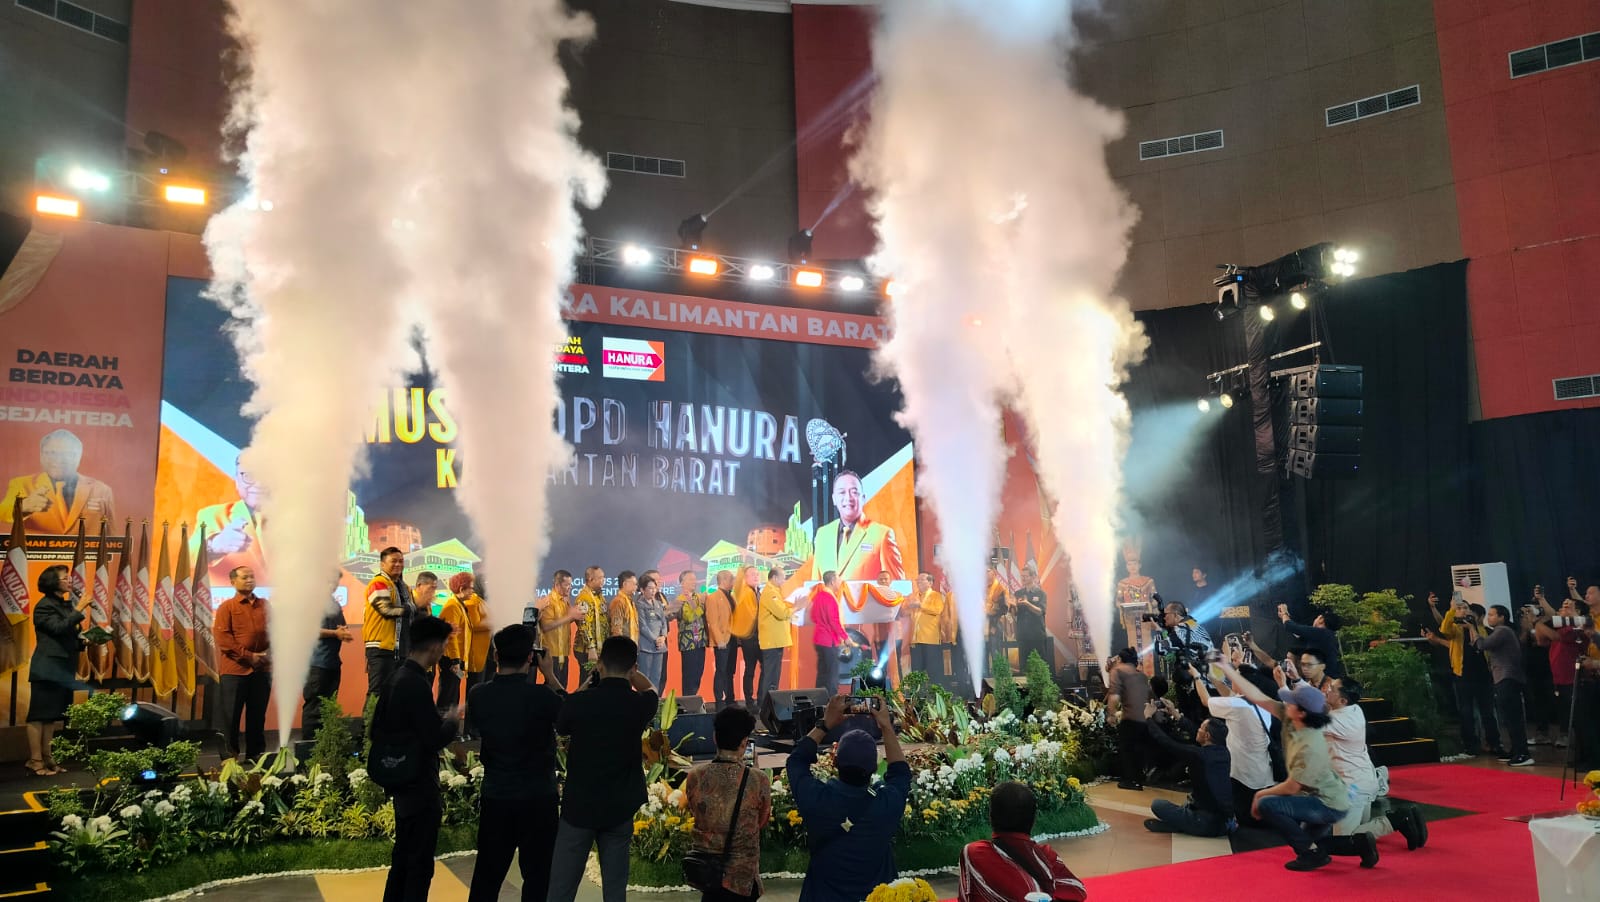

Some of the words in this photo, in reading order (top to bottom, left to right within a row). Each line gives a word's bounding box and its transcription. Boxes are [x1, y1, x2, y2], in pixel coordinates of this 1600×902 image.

[610, 296, 797, 334] KALIMANTAN
[808, 318, 891, 344] BARAT
[17, 348, 119, 371] DAERAH
[608, 351, 653, 366] HANURA
[9, 367, 124, 390] BERDAYA
[0, 386, 131, 409] INDONESIA
[0, 405, 134, 428] SEJAHTERA
[648, 400, 801, 464] HANURA
[652, 456, 741, 495] BARAT
